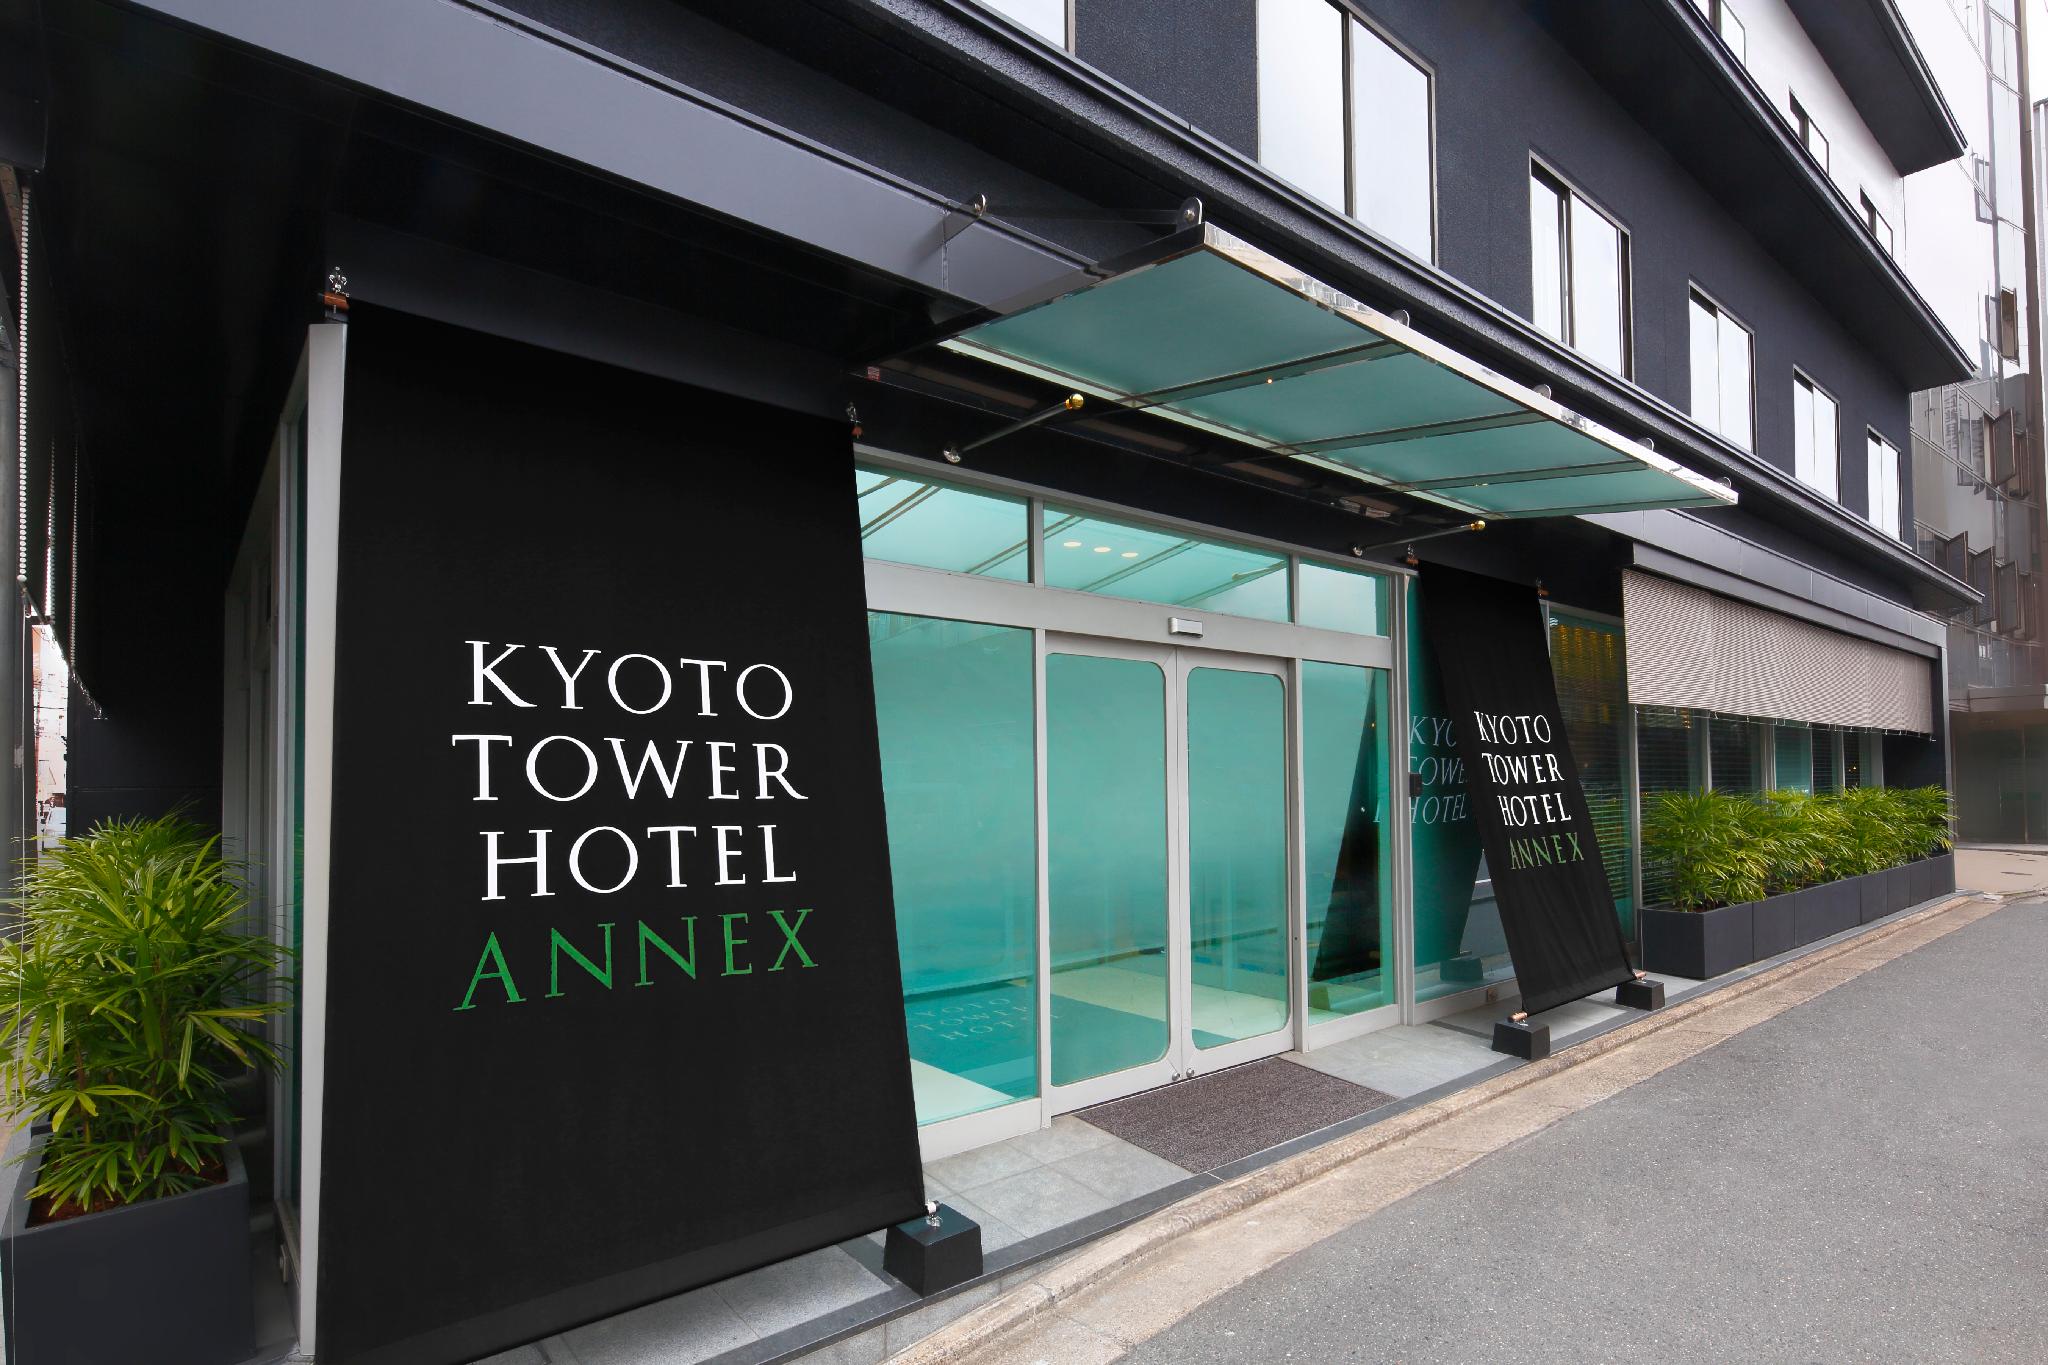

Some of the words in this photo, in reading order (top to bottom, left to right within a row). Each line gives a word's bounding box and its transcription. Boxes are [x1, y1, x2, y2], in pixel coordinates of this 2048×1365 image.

[465, 640, 793, 720] KYOTO
[1473, 710, 1551, 745] KYOTO
[452, 734, 809, 802] TOWER
[1481, 752, 1565, 786] TOWER
[1497, 792, 1572, 827] HOTEL
[479, 824, 797, 901] HOTEL
[1509, 832, 1585, 871] ANNEX
[453, 908, 818, 1011] ANNEX
